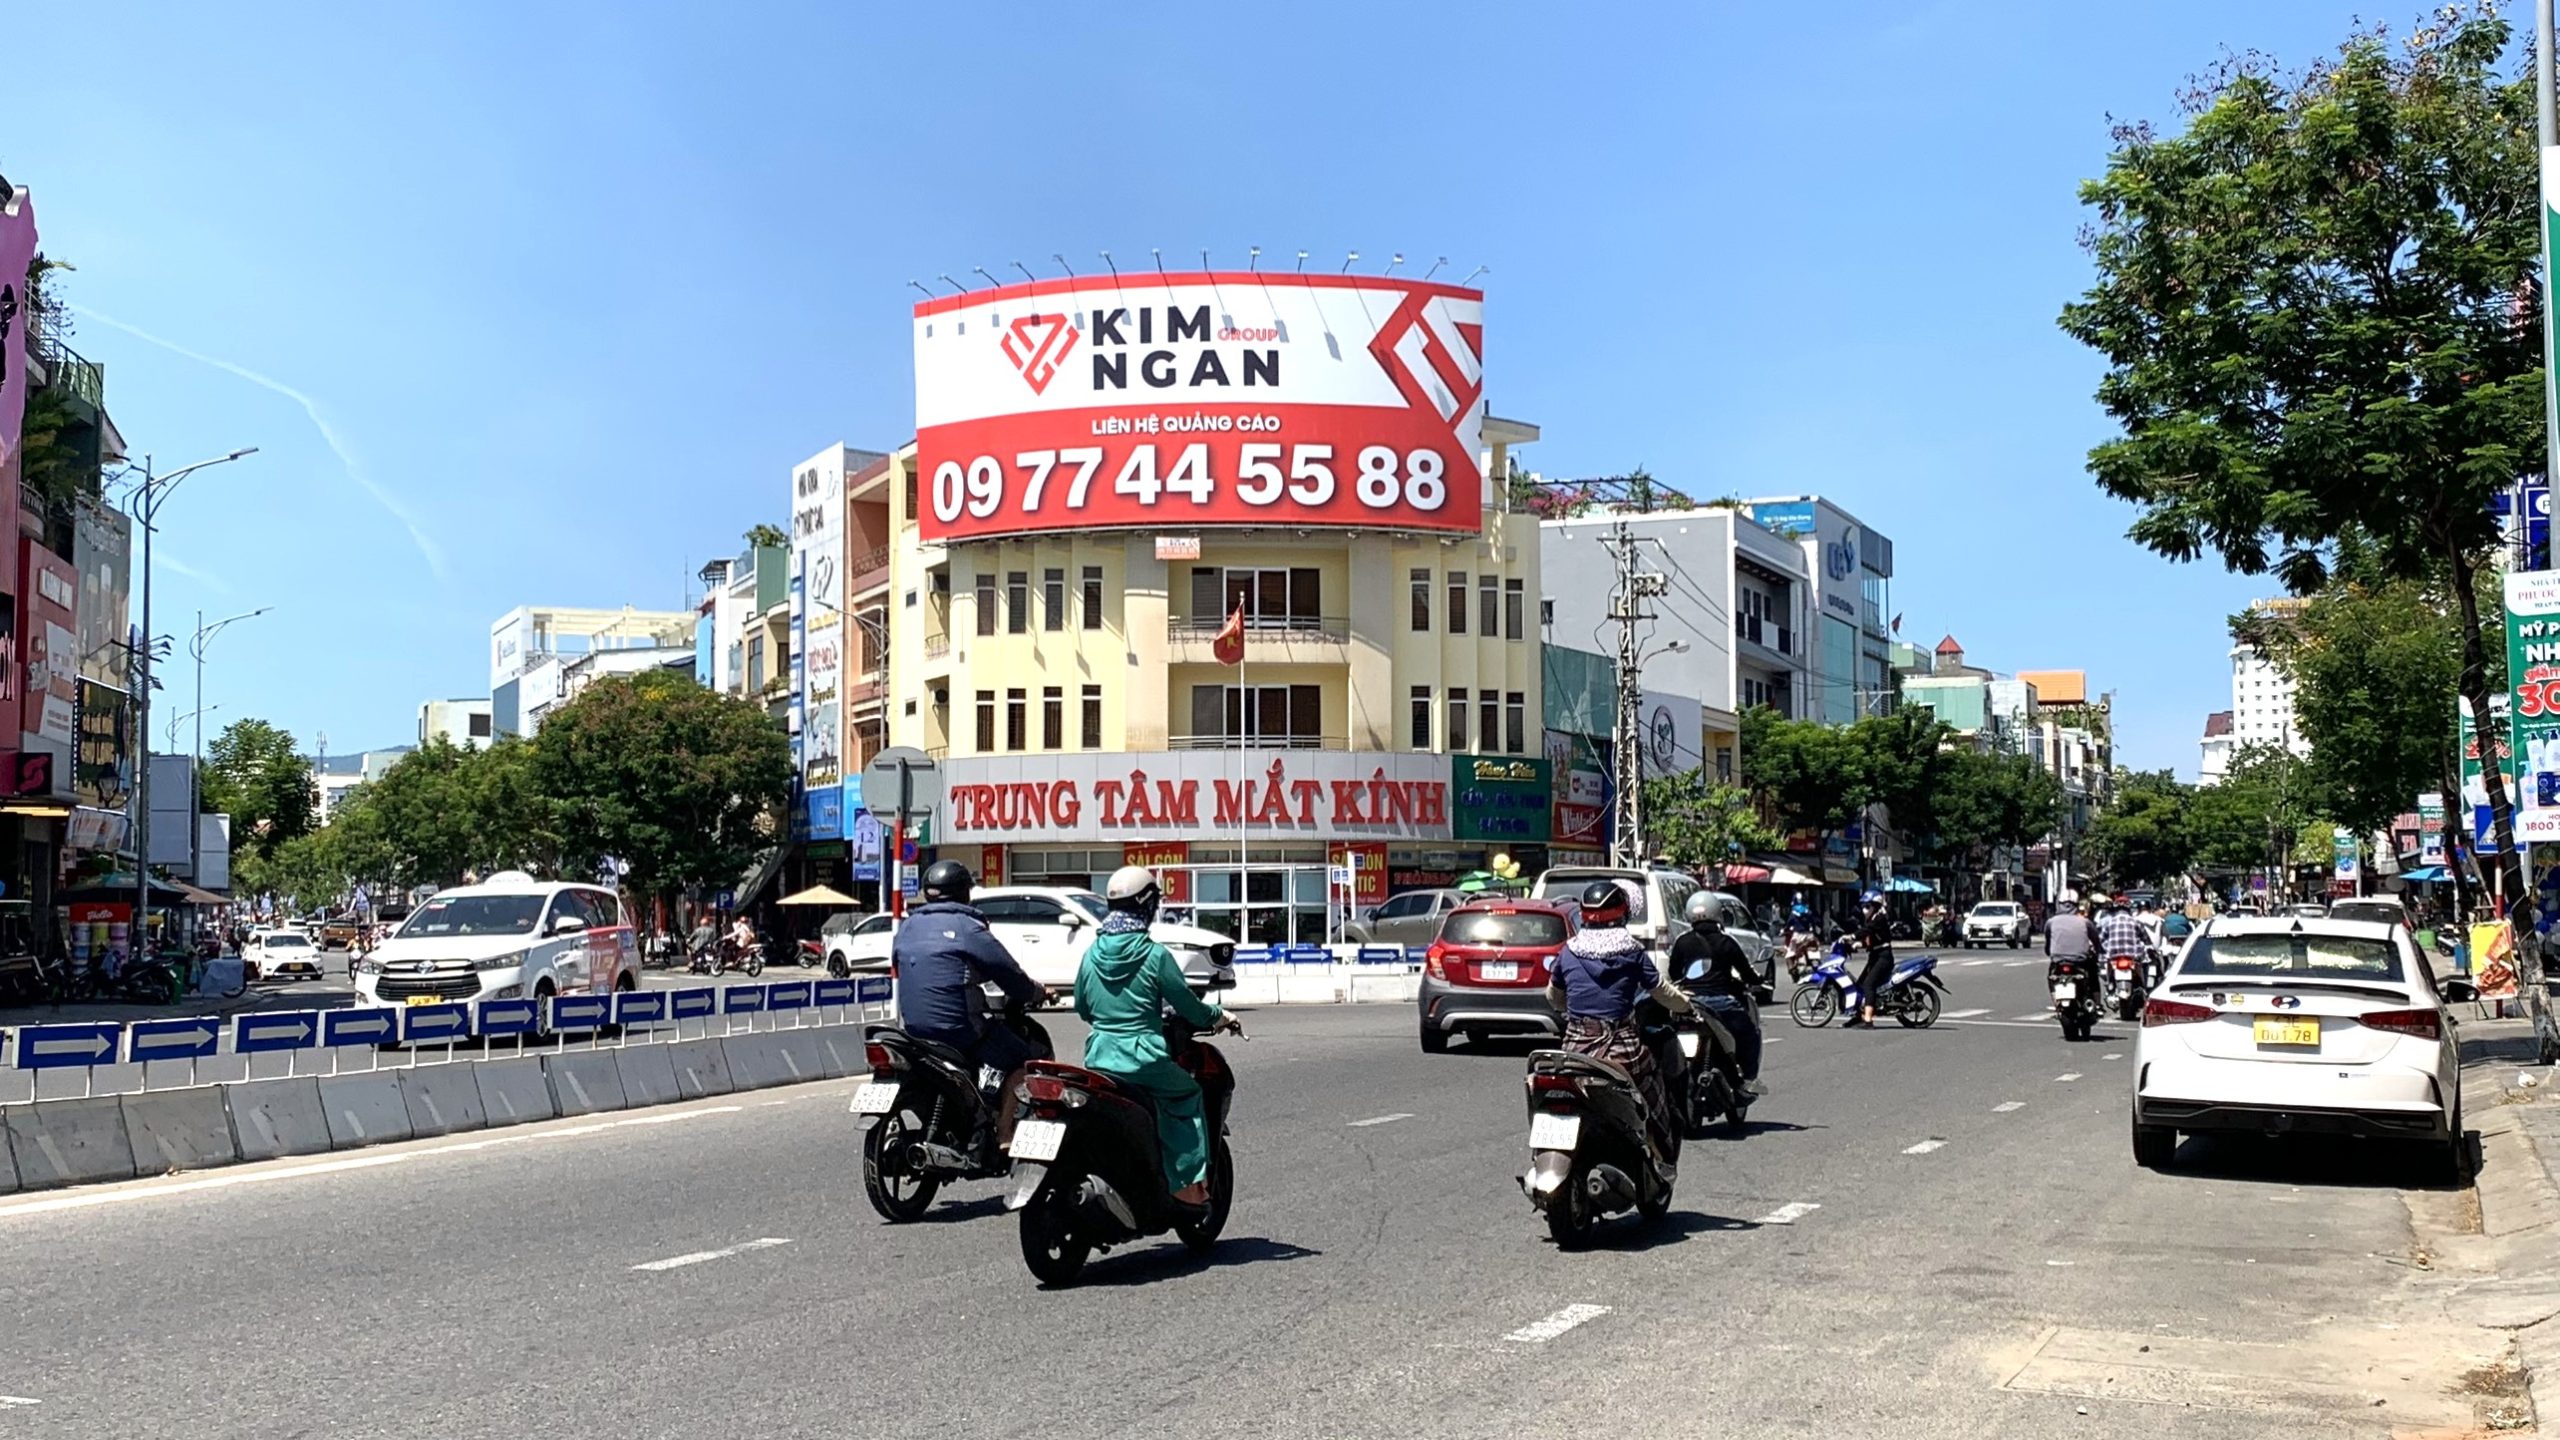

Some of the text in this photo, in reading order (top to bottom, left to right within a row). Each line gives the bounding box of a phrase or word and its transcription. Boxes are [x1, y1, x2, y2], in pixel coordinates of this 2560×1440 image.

[1093, 305, 1278, 346] KIM GROUP
[1093, 350, 1279, 390] NGAN
[1092, 411, 1280, 435] LIÊN HỆ QUẢNG CÁO
[933, 443, 1446, 522] 09 77 44 55 88
[2519, 620, 2544, 637] MỸ
[950, 758, 1446, 829] TRUNG TÂM MẮT KÍNH
[2525, 822, 2554, 831] 1800
[1365, 850, 1384, 870] ÒN
[720, 893, 730, 907] P
